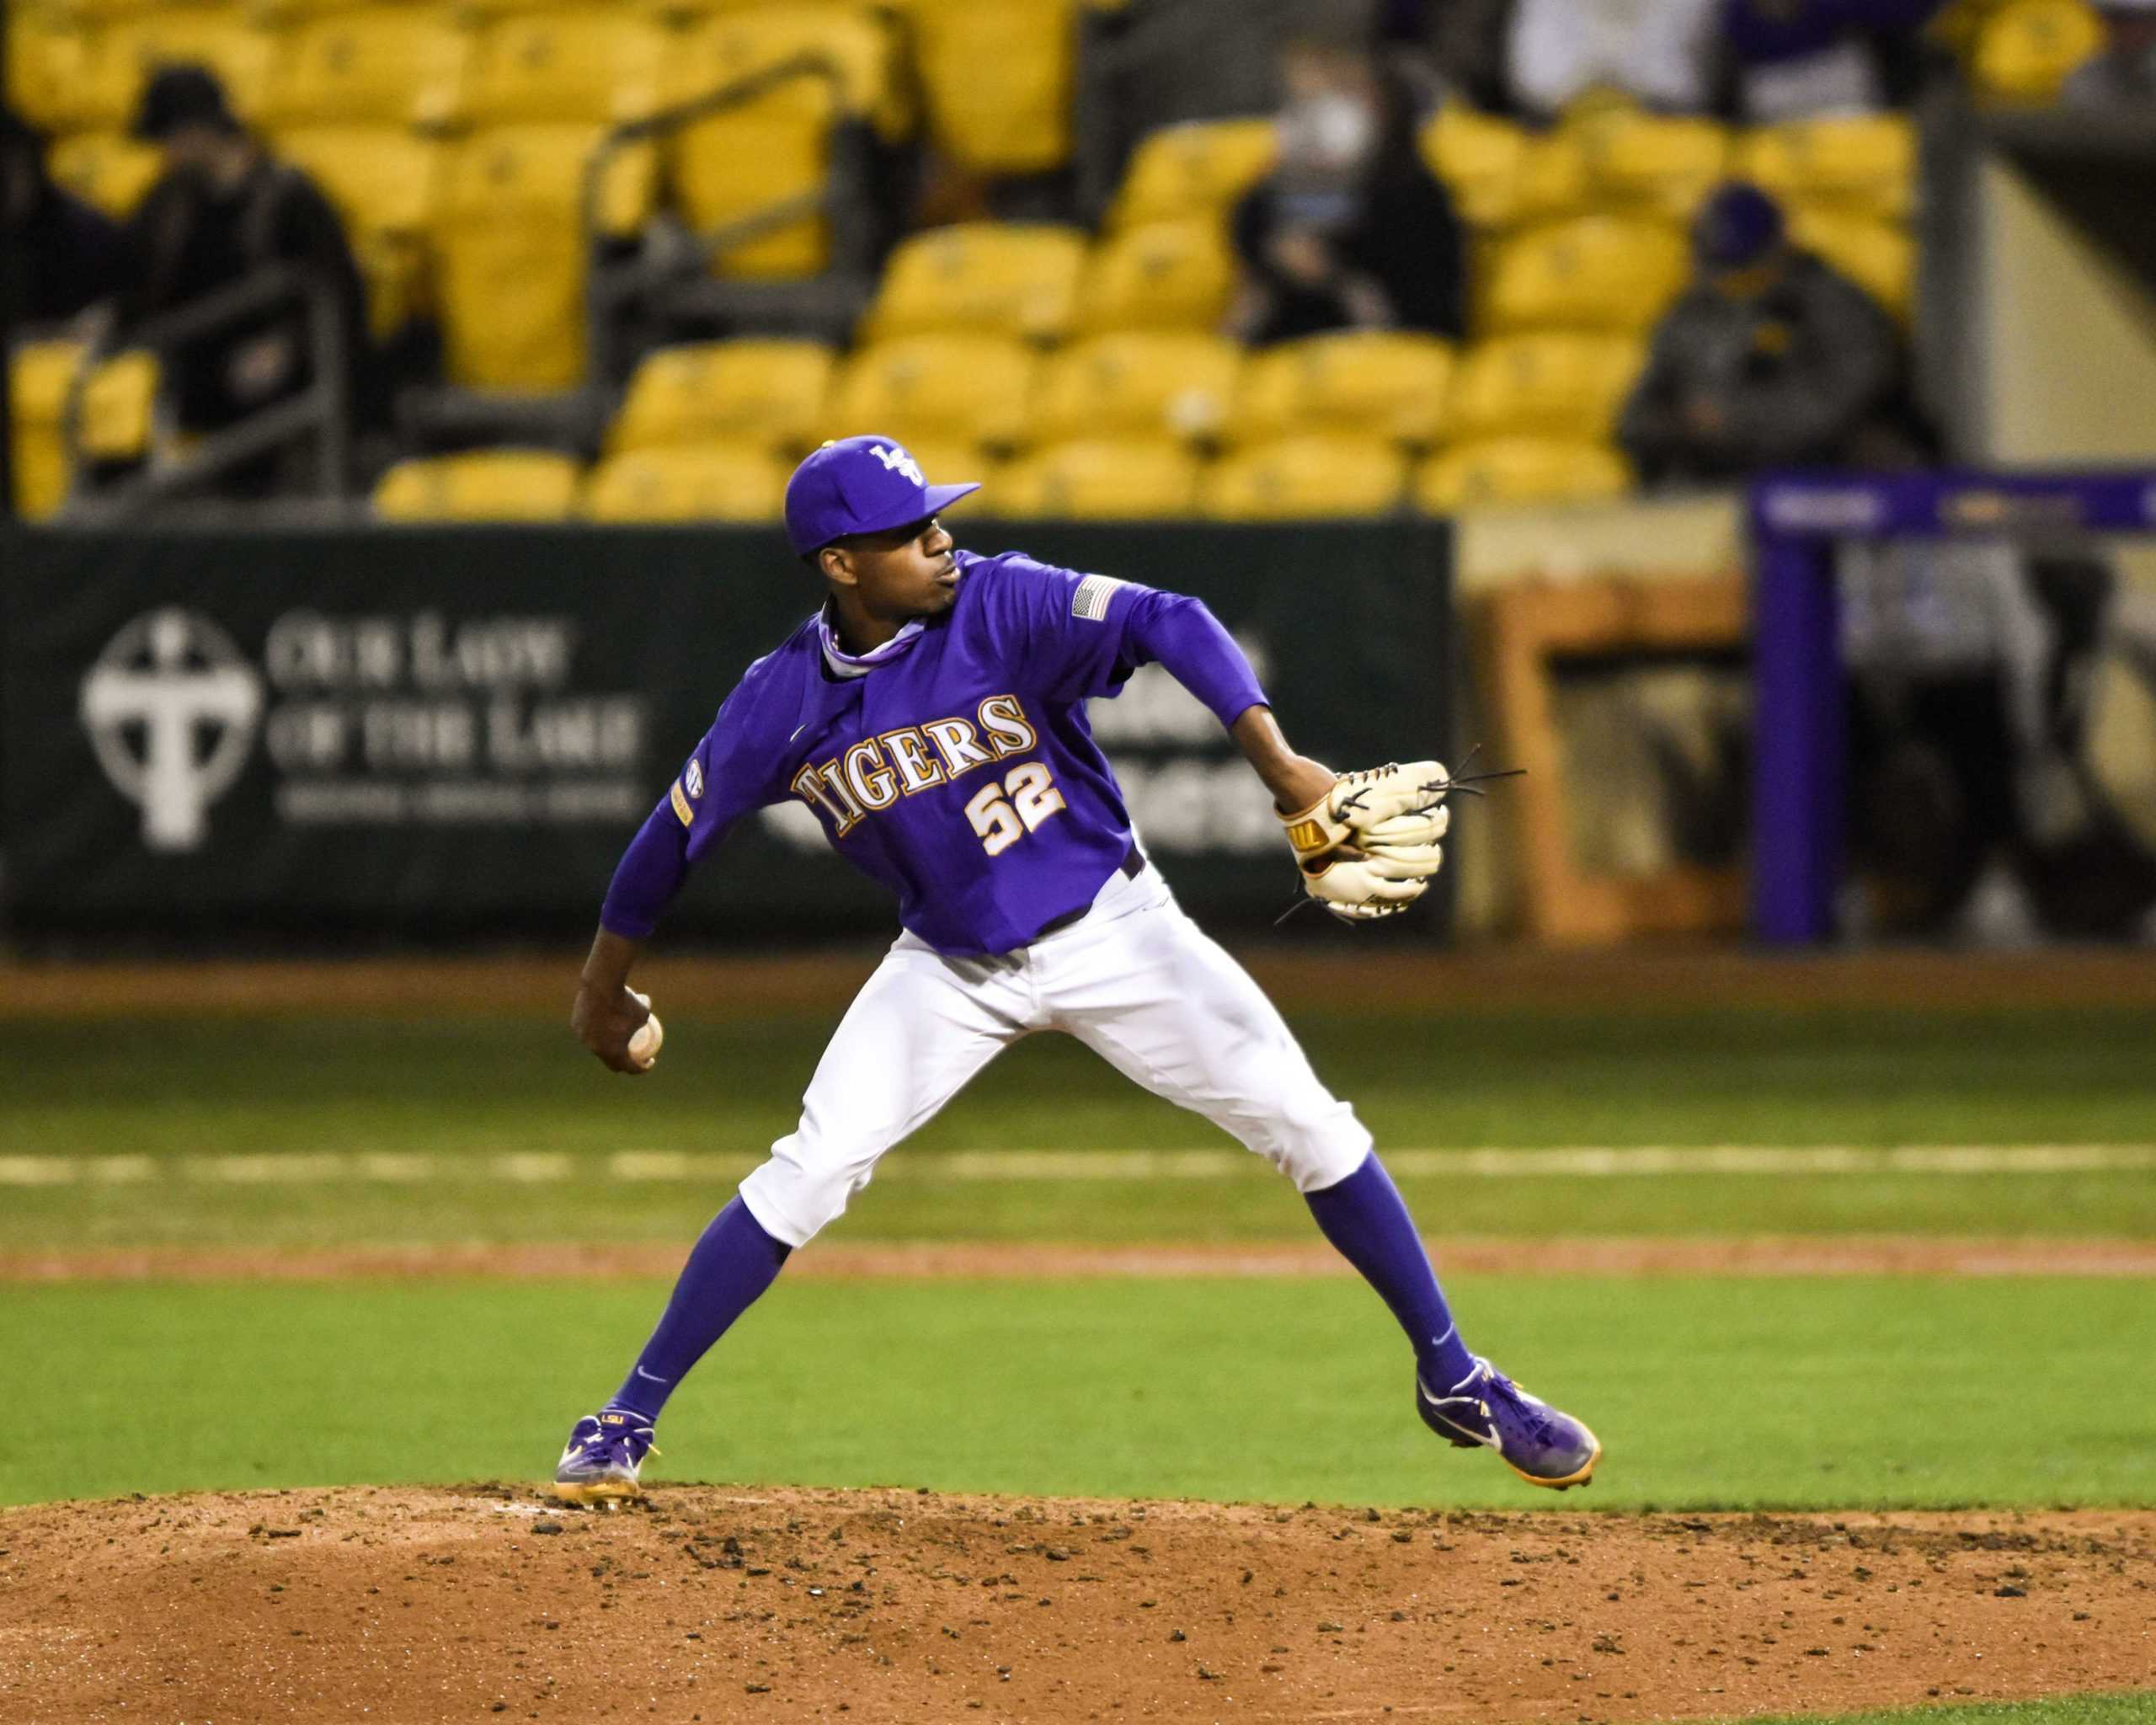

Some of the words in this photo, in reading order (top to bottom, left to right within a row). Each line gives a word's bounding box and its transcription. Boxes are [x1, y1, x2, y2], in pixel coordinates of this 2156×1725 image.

[790, 694, 1037, 838] TIGERS
[964, 761, 1065, 857] 52
[601, 1414, 624, 1424] LSU
